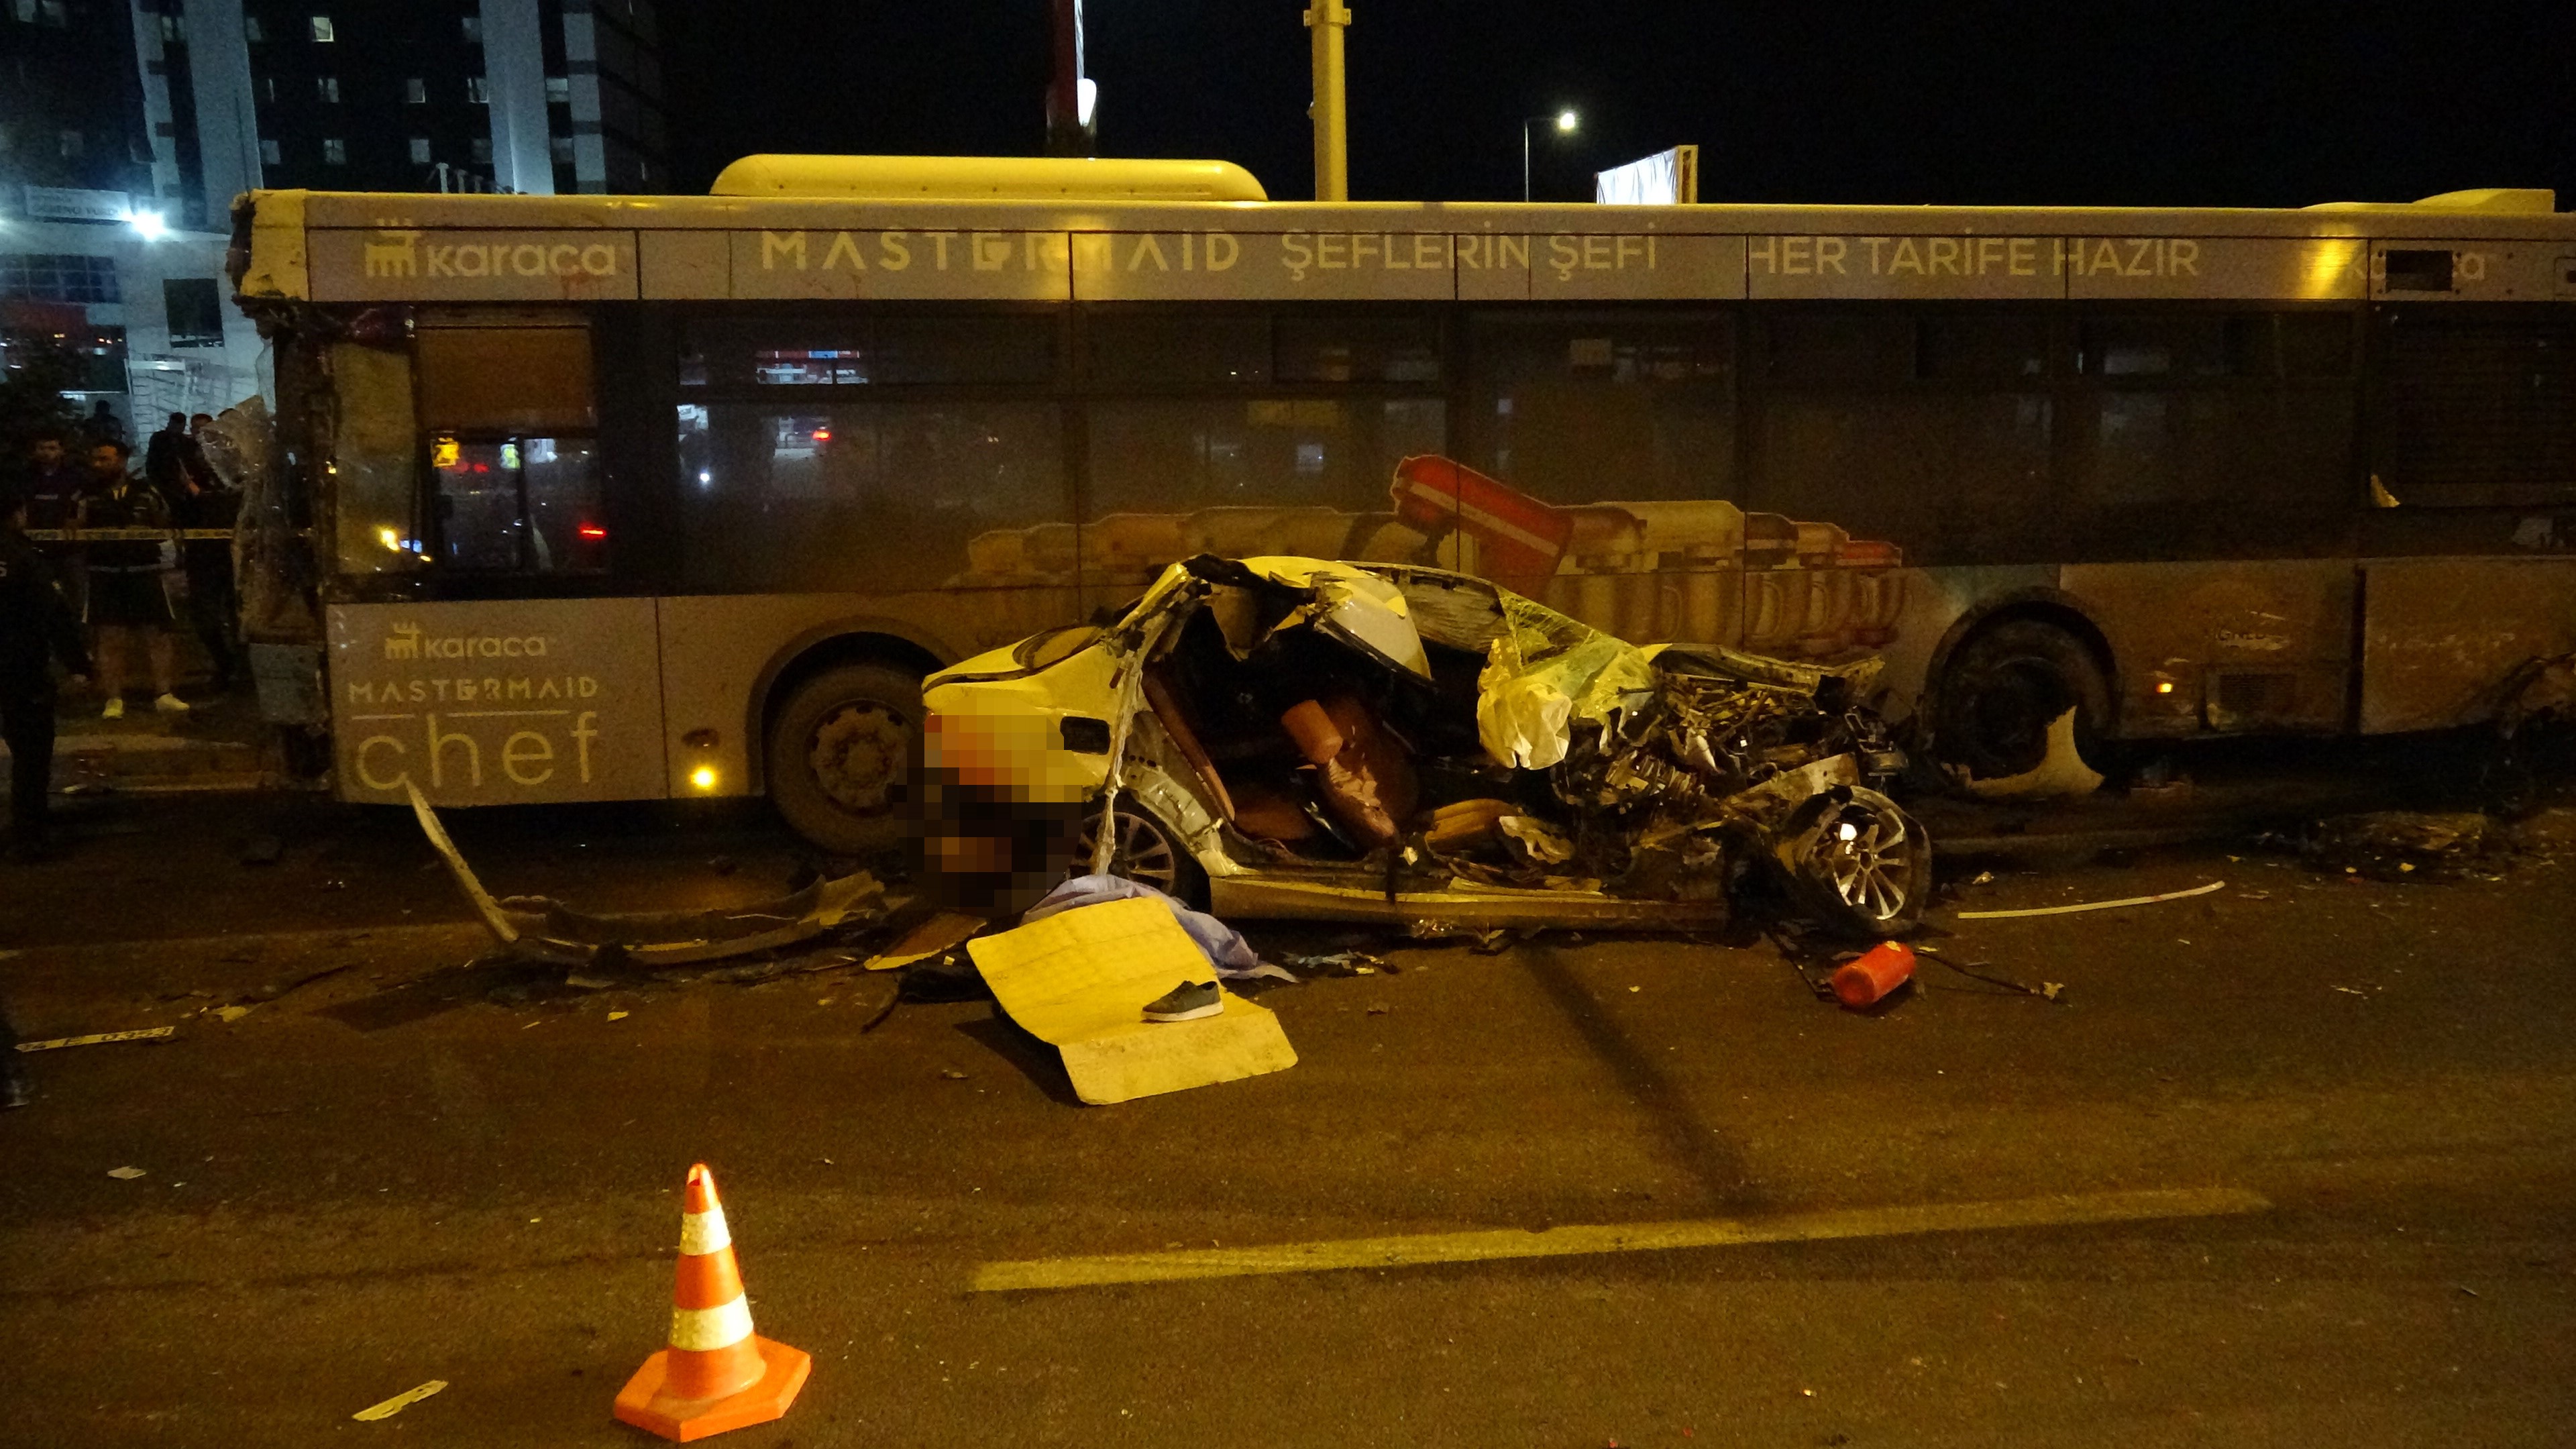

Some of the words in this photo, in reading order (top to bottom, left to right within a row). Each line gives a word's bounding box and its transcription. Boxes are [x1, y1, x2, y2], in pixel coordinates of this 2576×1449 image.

[427, 242, 616, 278] karaca
[1281, 219, 1530, 281] ŞEFLERİN
[1548, 221, 1656, 281] ŞEFİ
[1748, 235, 1847, 276] HER
[1860, 227, 2037, 276] TARİFE
[2053, 236, 2201, 277] HAZIR
[425, 637, 547, 657] karaca
[348, 676, 598, 703] MASTERMAID
[356, 711, 598, 790] chef
